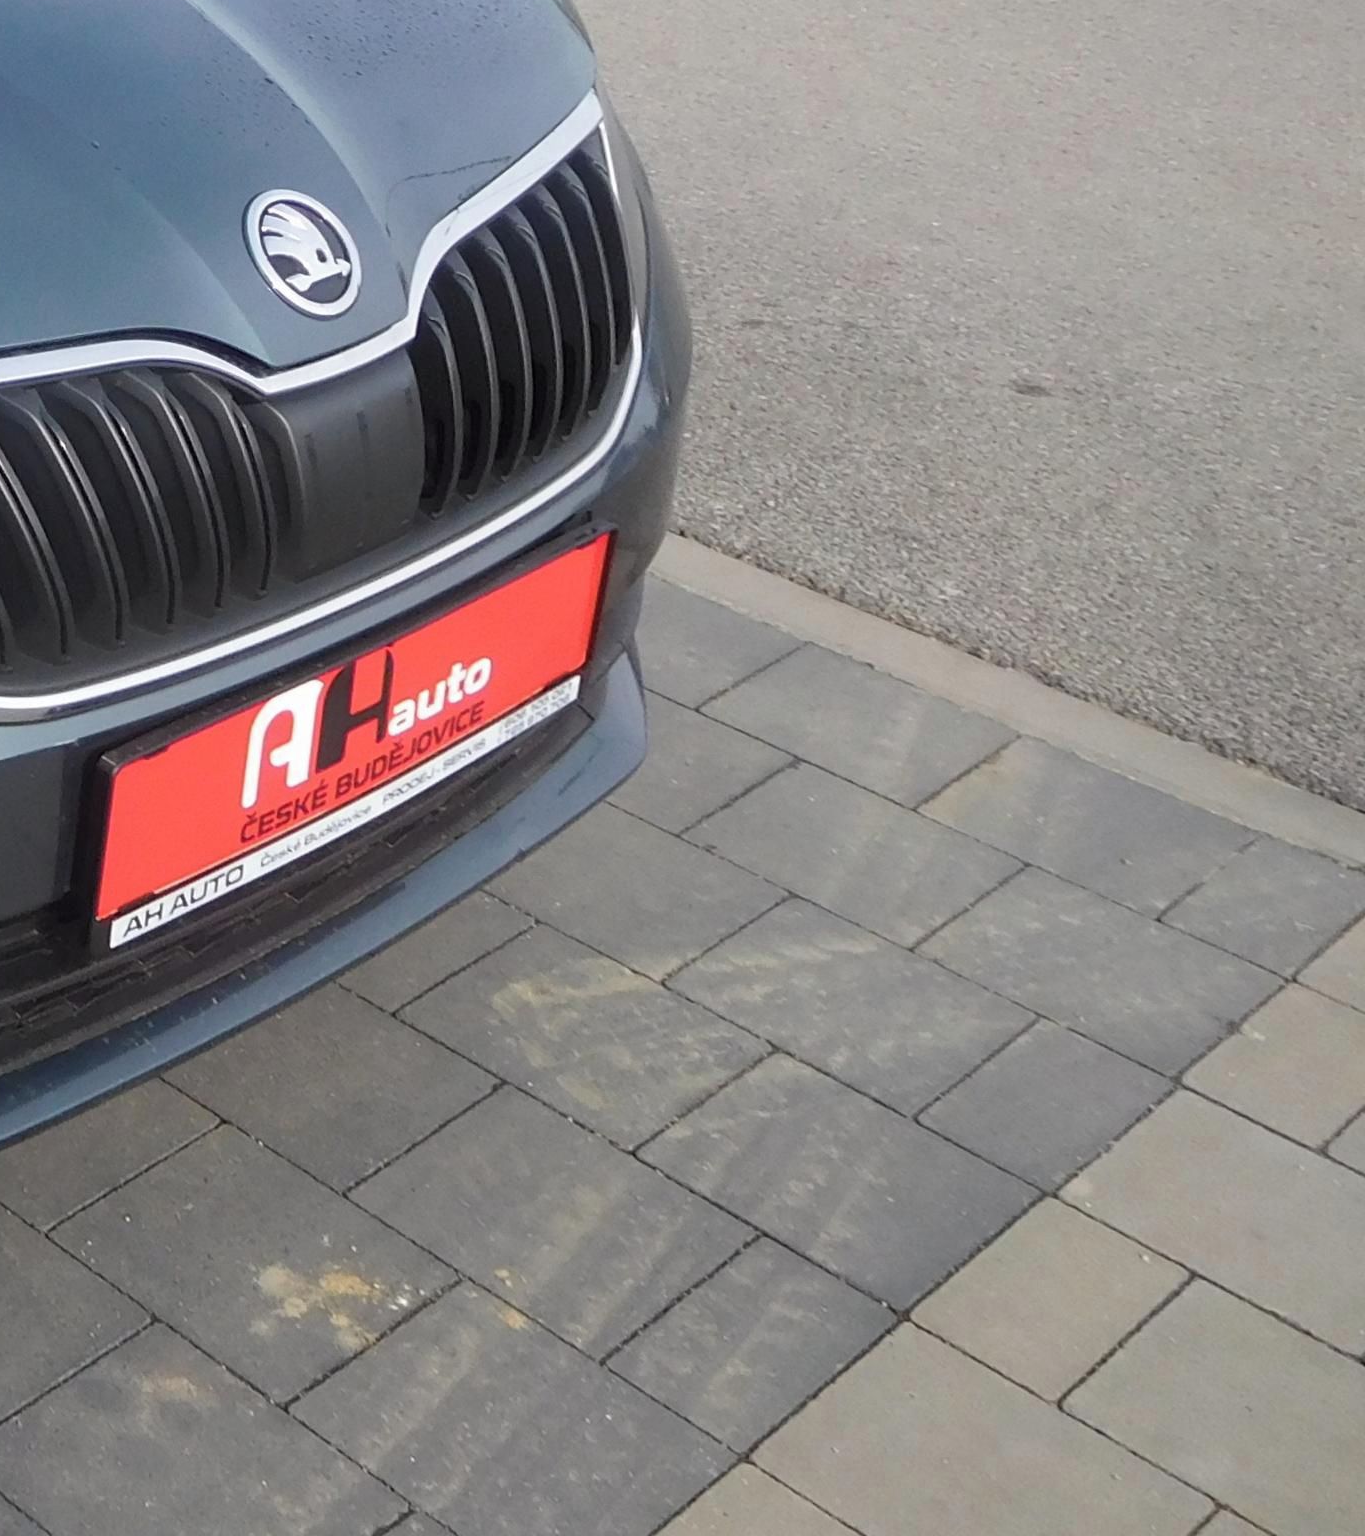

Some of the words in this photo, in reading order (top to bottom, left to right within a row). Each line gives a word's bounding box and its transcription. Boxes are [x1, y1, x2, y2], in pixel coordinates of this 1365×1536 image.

[387, 657, 492, 736] auto
[240, 778, 329, 844] ČESKÉ
[335, 700, 485, 800] BUDĚJOVICE
[123, 902, 164, 938] AH
[170, 864, 244, 915] AUTO
